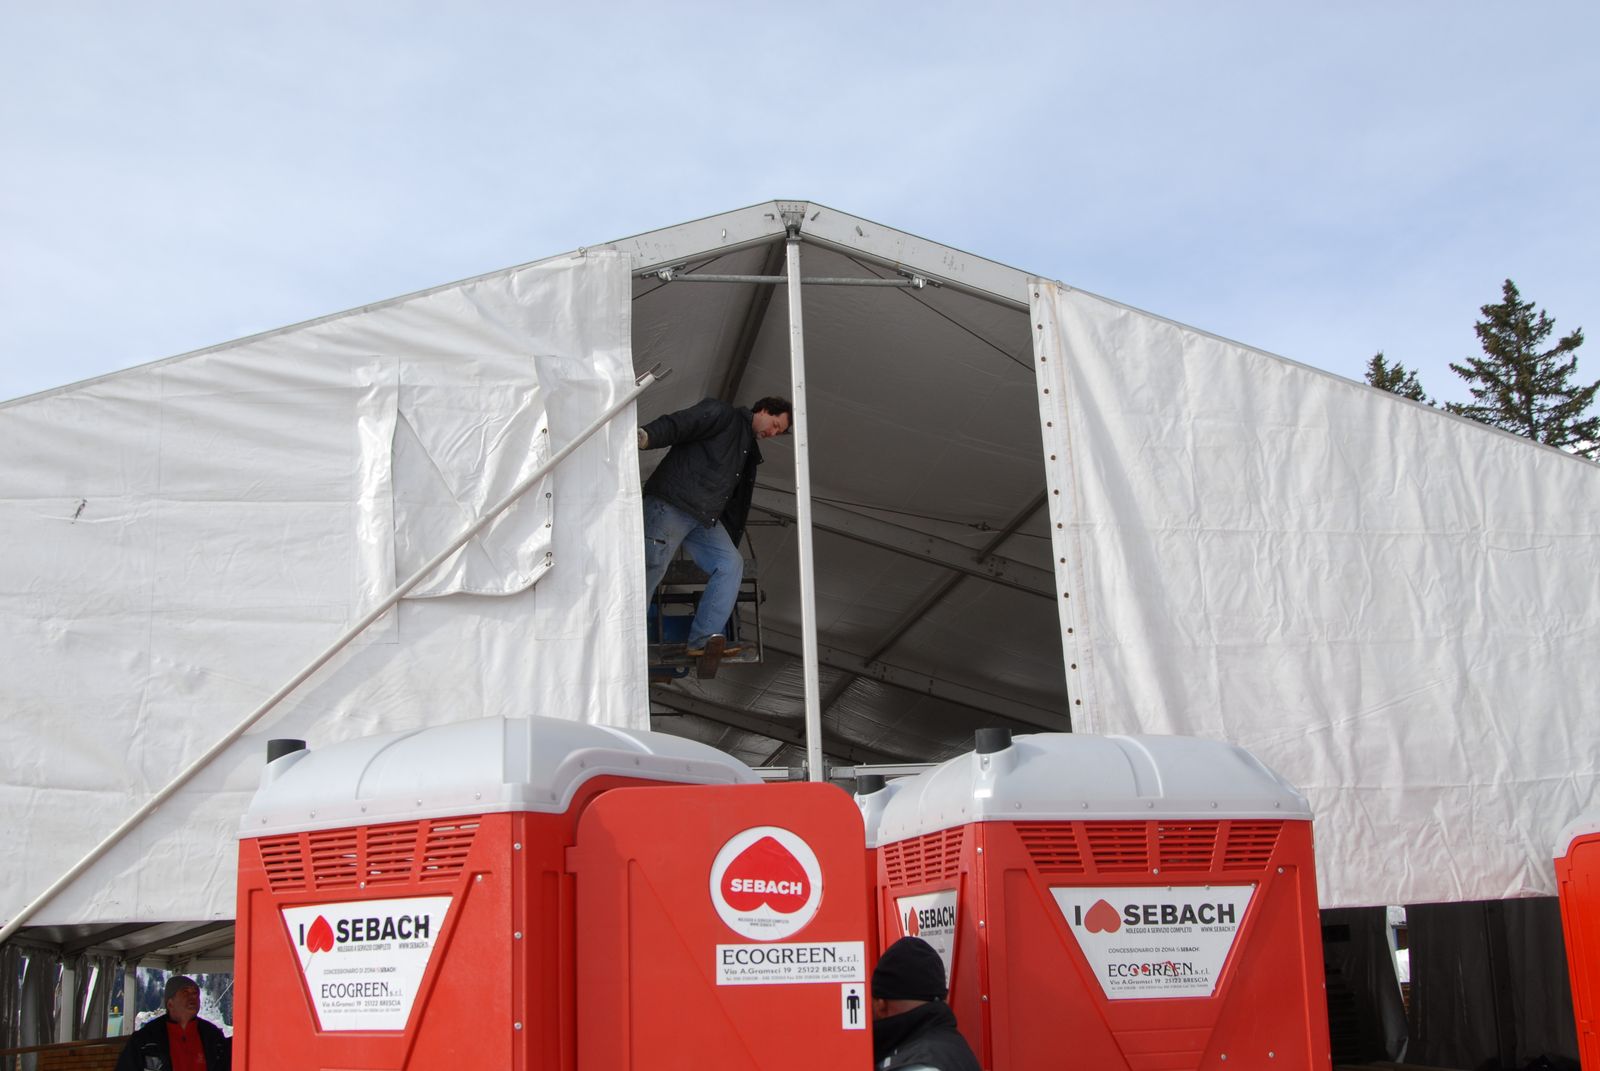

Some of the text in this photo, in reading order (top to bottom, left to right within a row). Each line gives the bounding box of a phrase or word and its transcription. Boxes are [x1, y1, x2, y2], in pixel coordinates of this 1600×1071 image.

[730, 878, 802, 895] SEBACH
[904, 905, 955, 931] I SEBACH
[1074, 903, 1235, 926] I SEBACH
[299, 914, 430, 946] I SEBACH
[1125, 926, 1147, 934] NOLEGGIO
[722, 947, 860, 965] ECOGREEN s.r.l.
[740, 967, 781, 975] A.Gramsci
[797, 966, 820, 974] 25122
[1107, 962, 1193, 977] ECOGREEN
[321, 982, 389, 999] ECOGREEN
